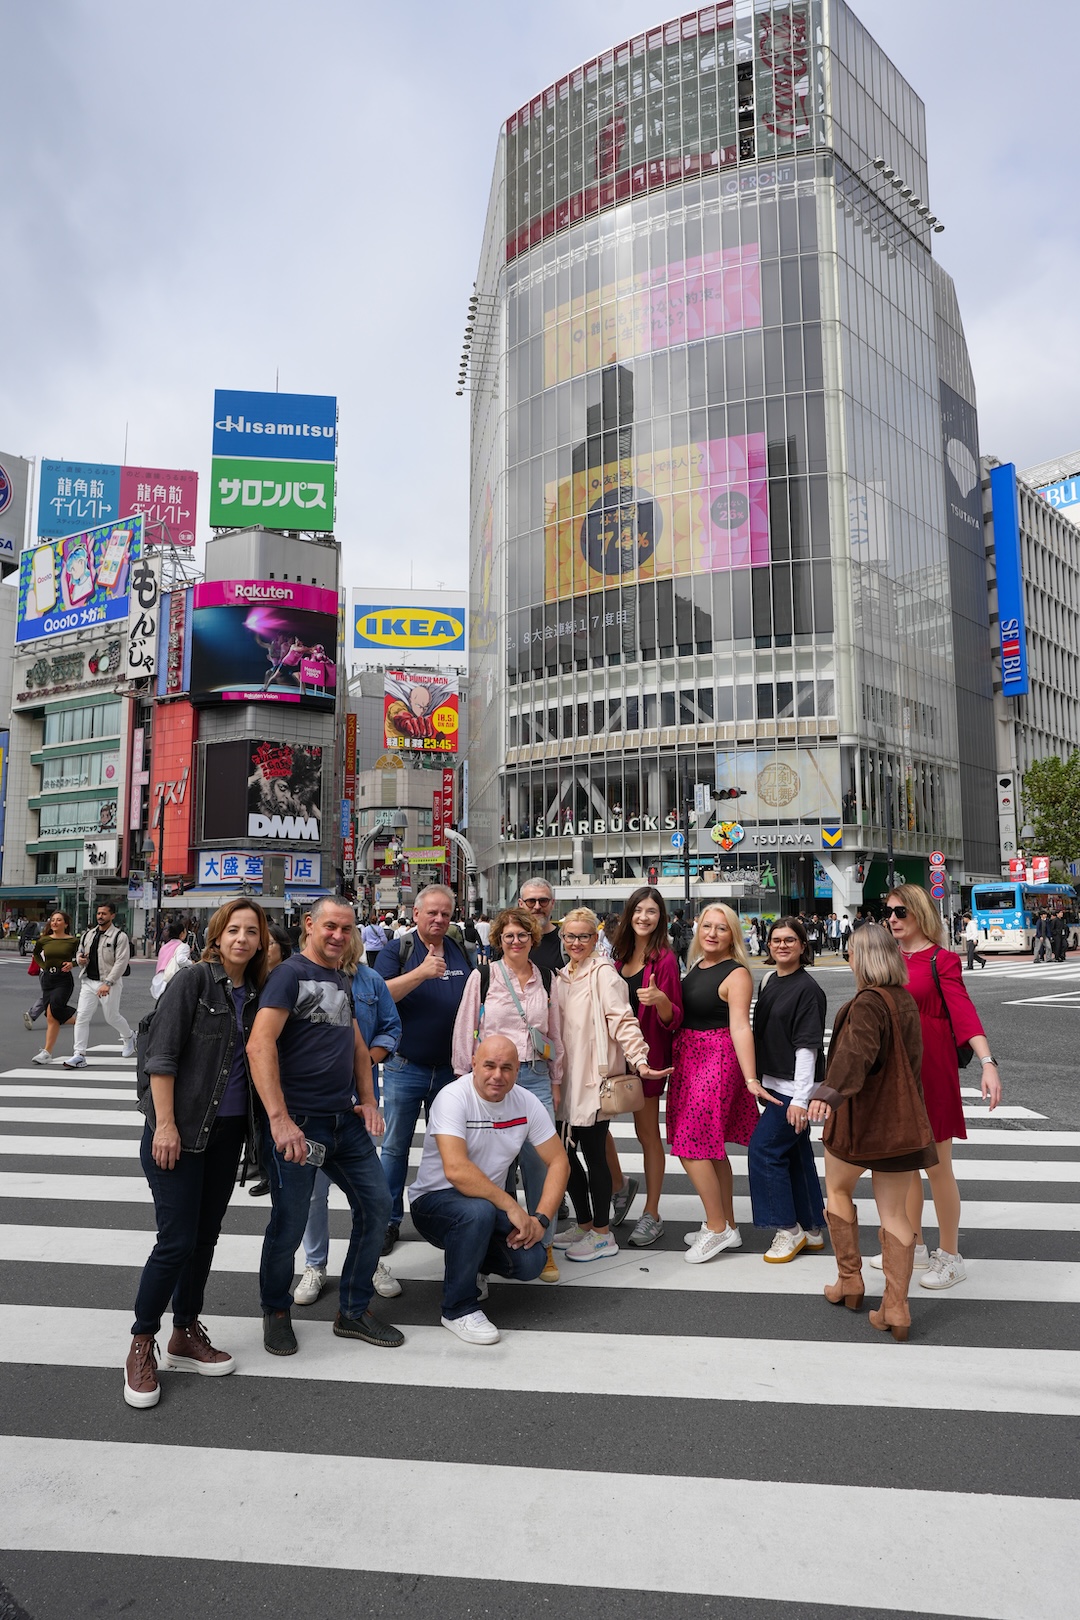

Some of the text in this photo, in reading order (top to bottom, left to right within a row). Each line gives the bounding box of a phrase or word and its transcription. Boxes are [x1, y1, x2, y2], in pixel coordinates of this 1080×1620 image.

[721, 168, 791, 193] QFRONT
[215, 415, 334, 438] Hisamitsu
[57, 477, 104, 499] 龍角散
[137, 483, 183, 504] 龍角散
[218, 478, 327, 510] サロンパス
[950, 503, 980, 530] TSUTAYA
[235, 584, 293, 601] Rakuten
[43, 613, 79, 632] Qoo10
[130, 560, 157, 674] もんじゃ
[366, 618, 456, 637] IKEA
[152, 766, 190, 830] クスリ
[444, 773, 452, 817] カラオケ
[248, 813, 319, 840] DMM
[535, 813, 677, 838] STARBUCKS
[752, 833, 814, 846] TSUTAYA
[205, 856, 313, 878] 大盛堂店
